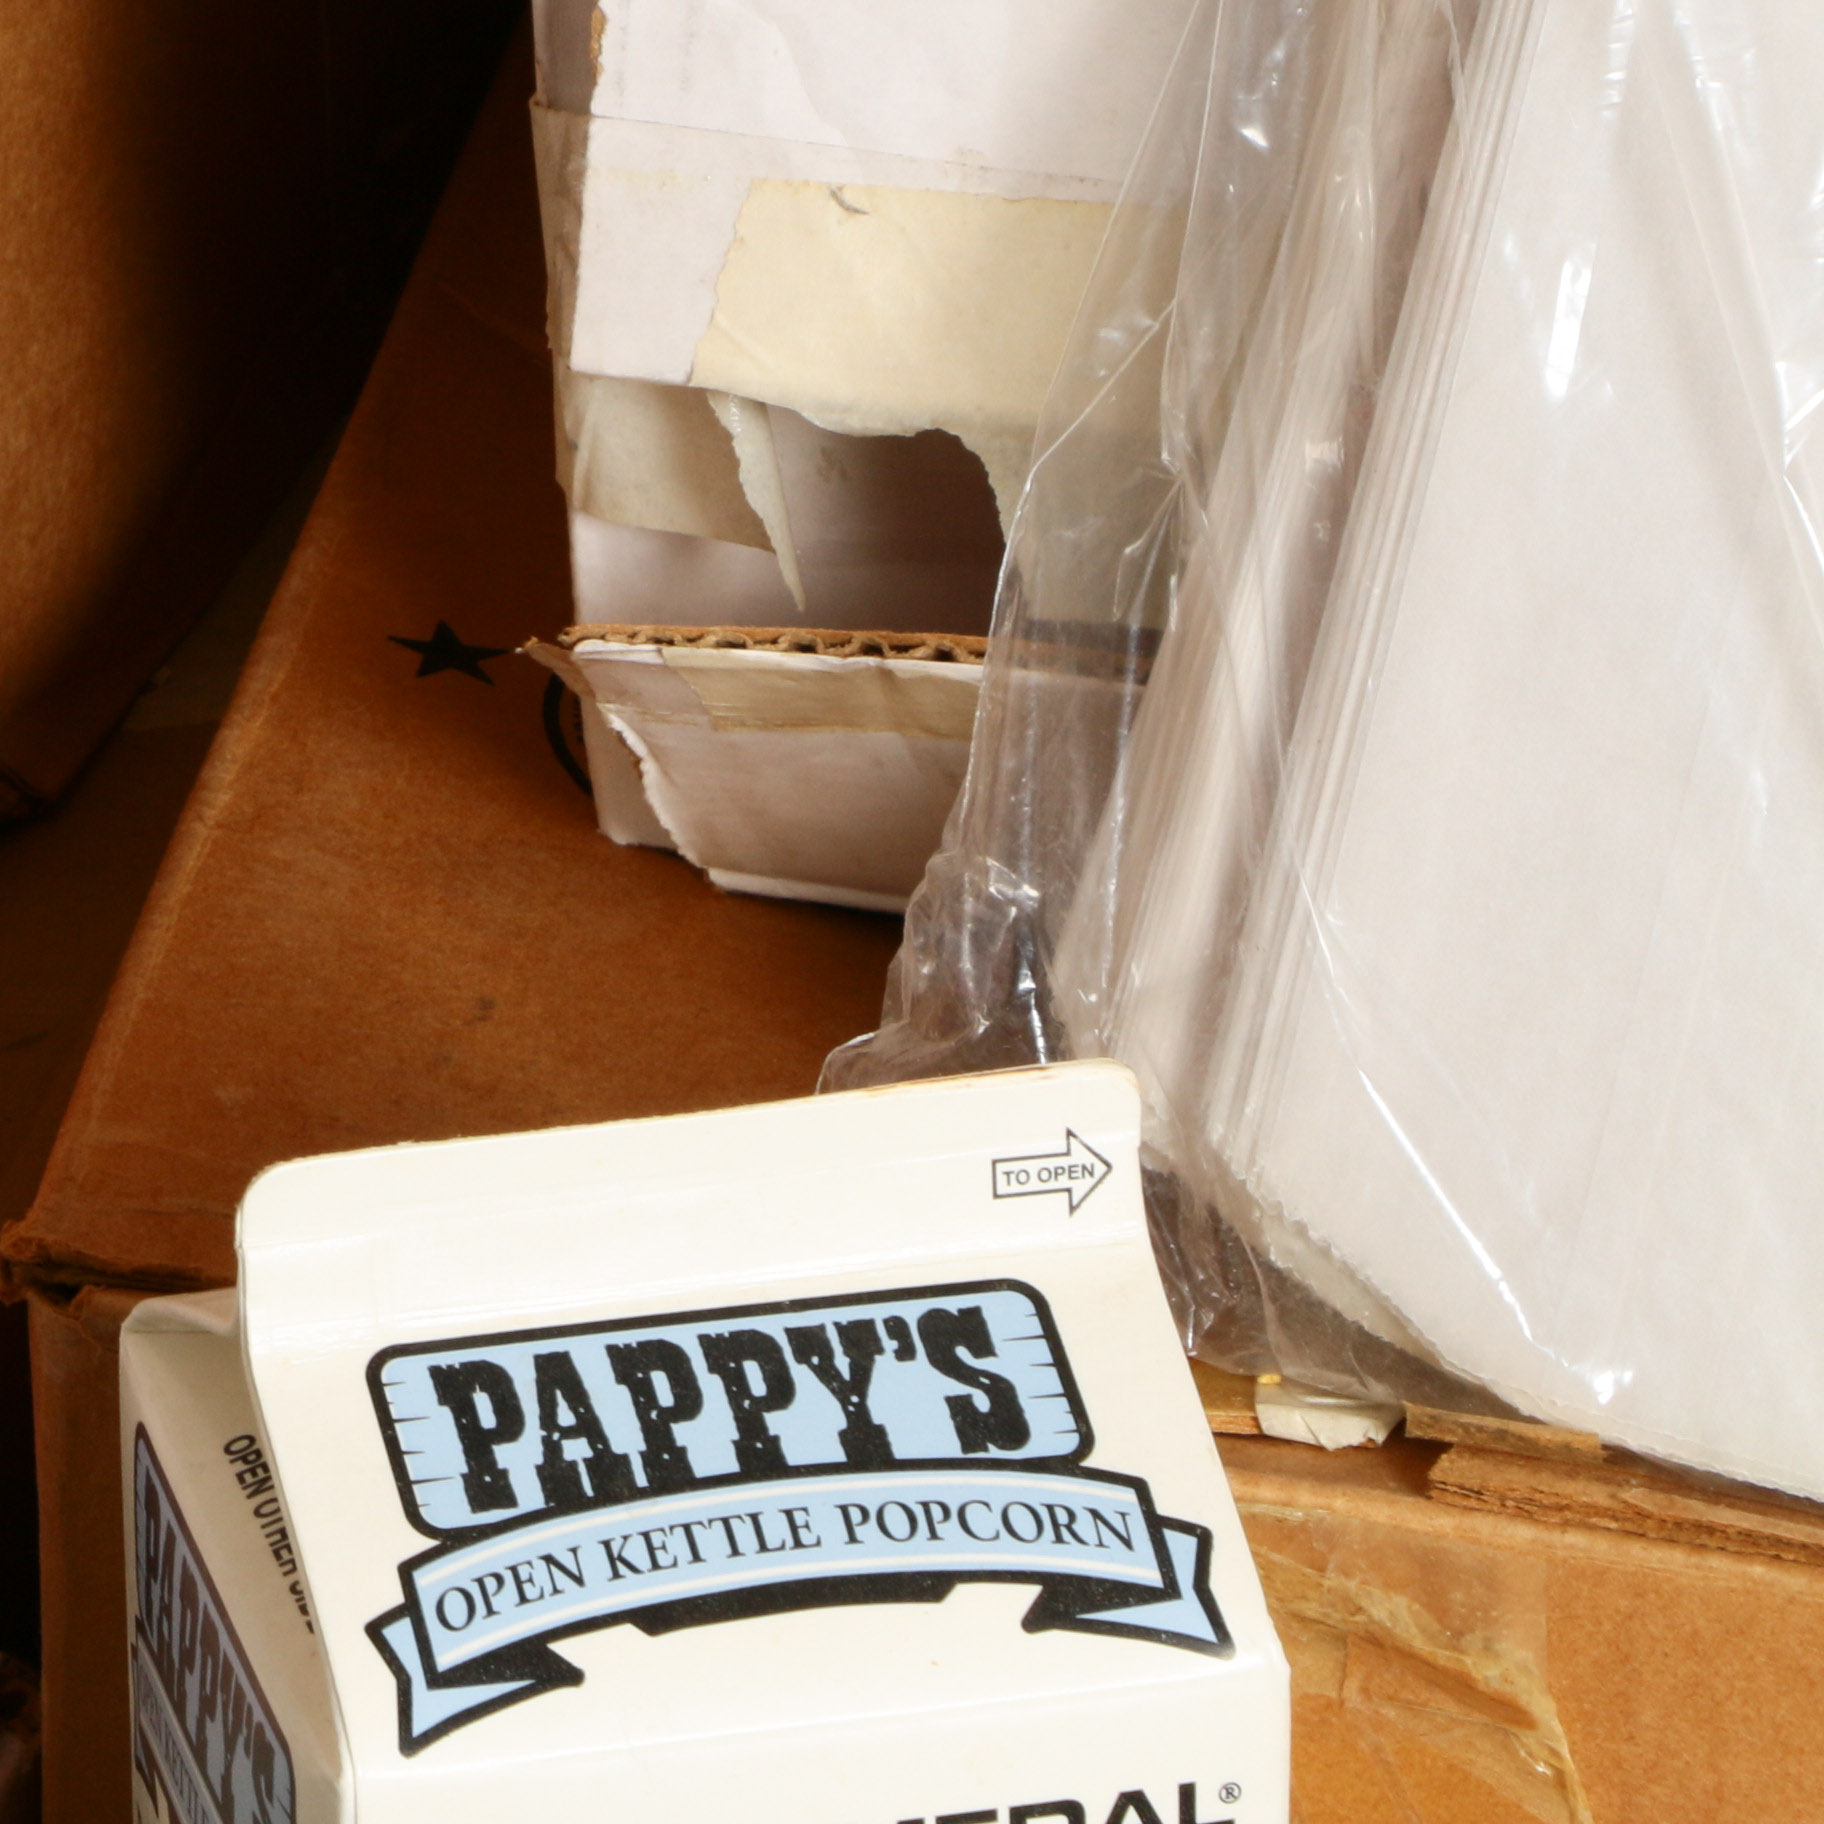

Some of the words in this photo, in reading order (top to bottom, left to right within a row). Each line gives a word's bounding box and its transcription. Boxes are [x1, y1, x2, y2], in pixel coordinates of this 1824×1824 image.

[1001, 1169, 1031, 1187] TO
[1037, 1163, 1095, 1183] OPEN
[427, 1305, 1031, 1514] PAPPY'S
[223, 1434, 275, 1500] OPEN
[433, 1547, 590, 1633] OPEN
[603, 1507, 822, 1583] KETTLE
[841, 1499, 1136, 1552] POPCORN
